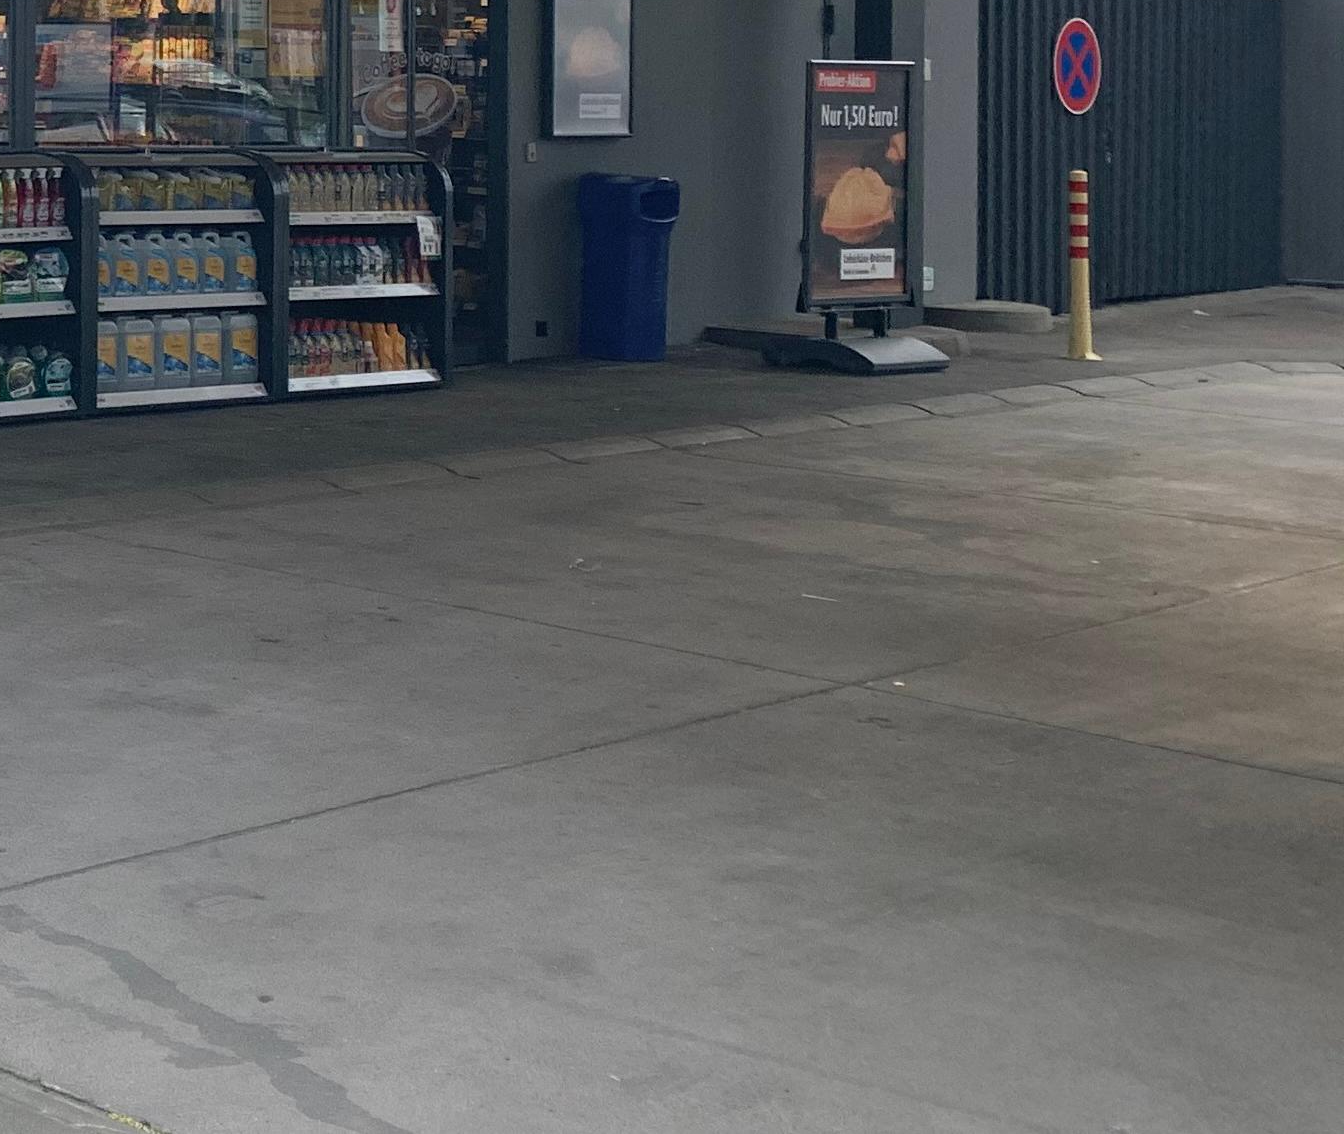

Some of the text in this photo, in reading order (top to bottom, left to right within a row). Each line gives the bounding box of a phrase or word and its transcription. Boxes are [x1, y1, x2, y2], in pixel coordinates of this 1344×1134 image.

[821, 104, 898, 130] Nur 1,50 Euro!
